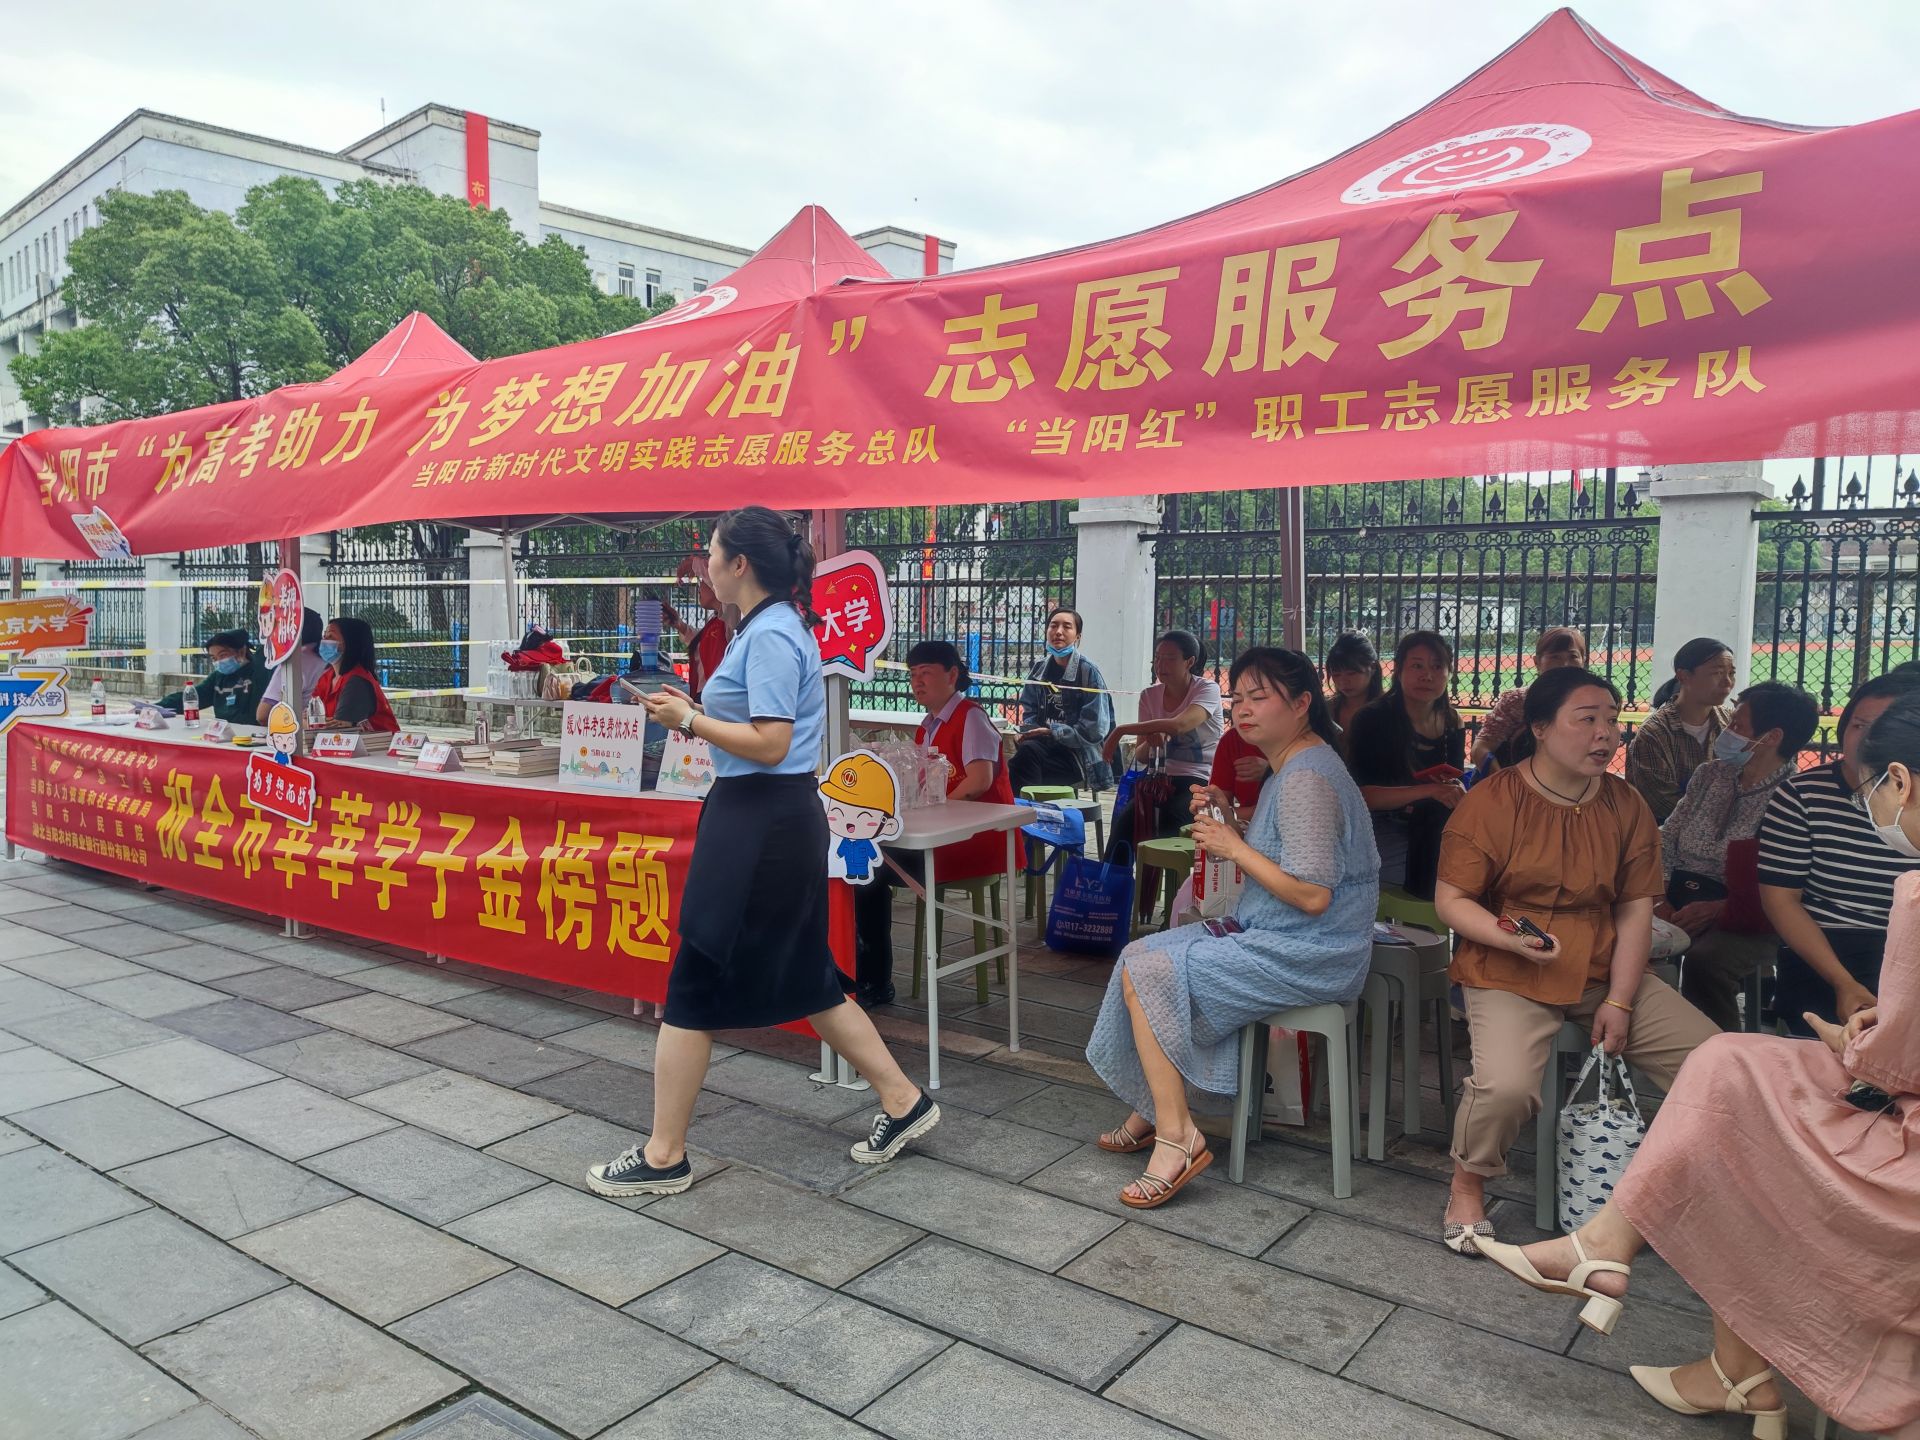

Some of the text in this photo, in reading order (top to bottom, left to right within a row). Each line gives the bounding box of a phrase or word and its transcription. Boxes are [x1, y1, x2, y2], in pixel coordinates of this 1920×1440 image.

[924, 167, 1773, 403] 志愿服务点
[411, 425, 940, 488] 当阳市新时代文明实践志愿服务总队
[567, 714, 639, 741] 暖心伴考免费饮水点
